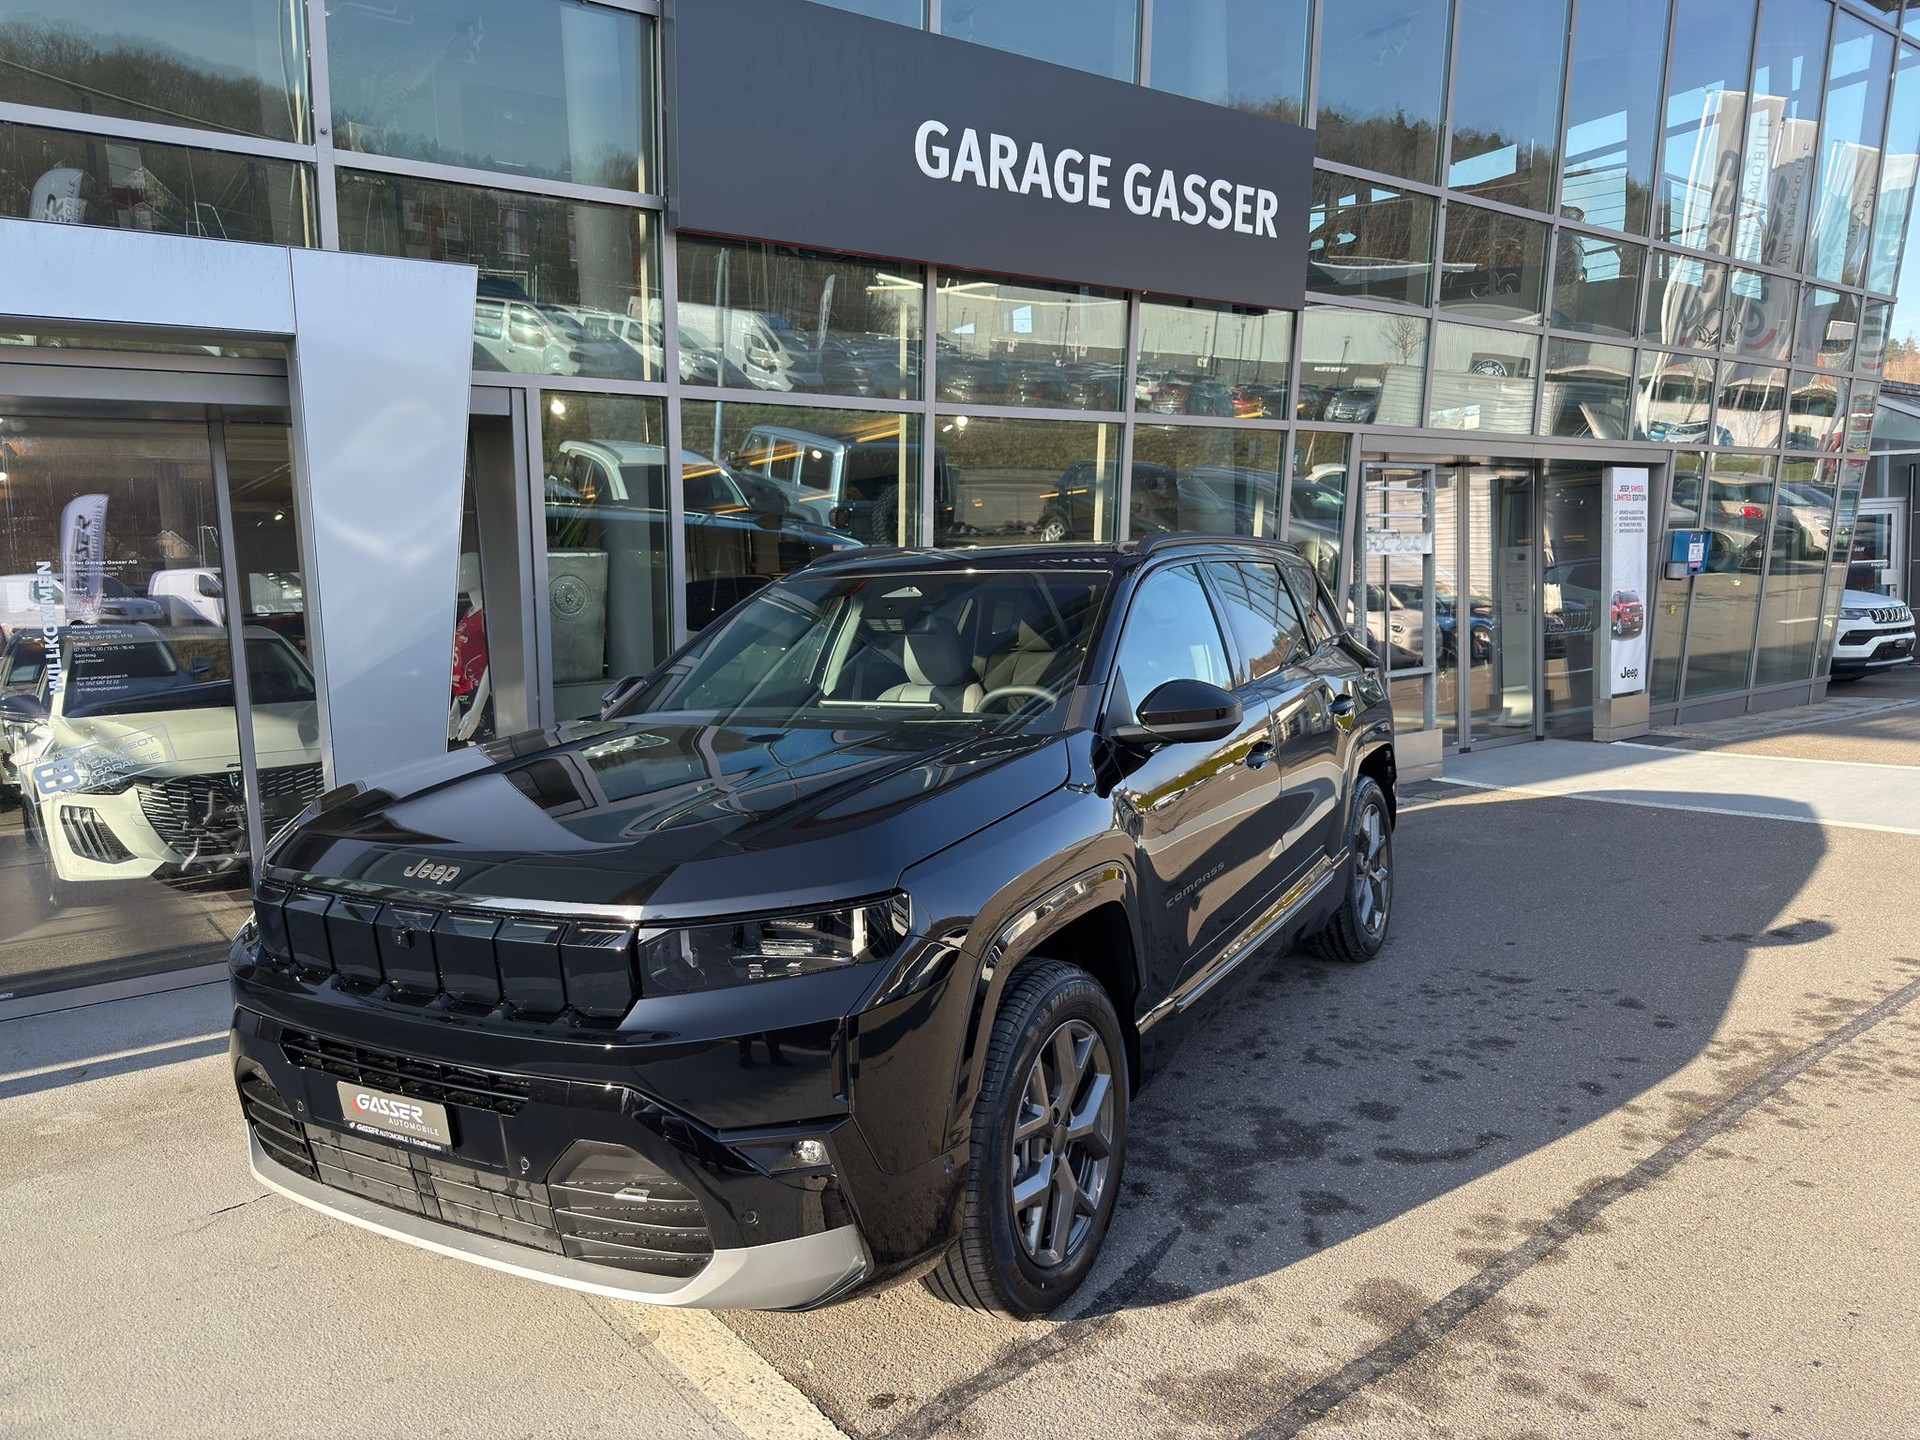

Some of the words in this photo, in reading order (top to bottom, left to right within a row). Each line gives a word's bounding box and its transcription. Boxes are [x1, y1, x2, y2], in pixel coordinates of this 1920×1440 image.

[914, 119, 1112, 210] GARAGE
[1122, 162, 1279, 239] GASSER
[36, 561, 65, 698] WILLKOMMEN
[1620, 665, 1639, 680] Jeep
[403, 858, 461, 885] Jeep
[356, 1093, 425, 1124] GASSER
[388, 1117, 440, 1137] AUTOMOBILE
